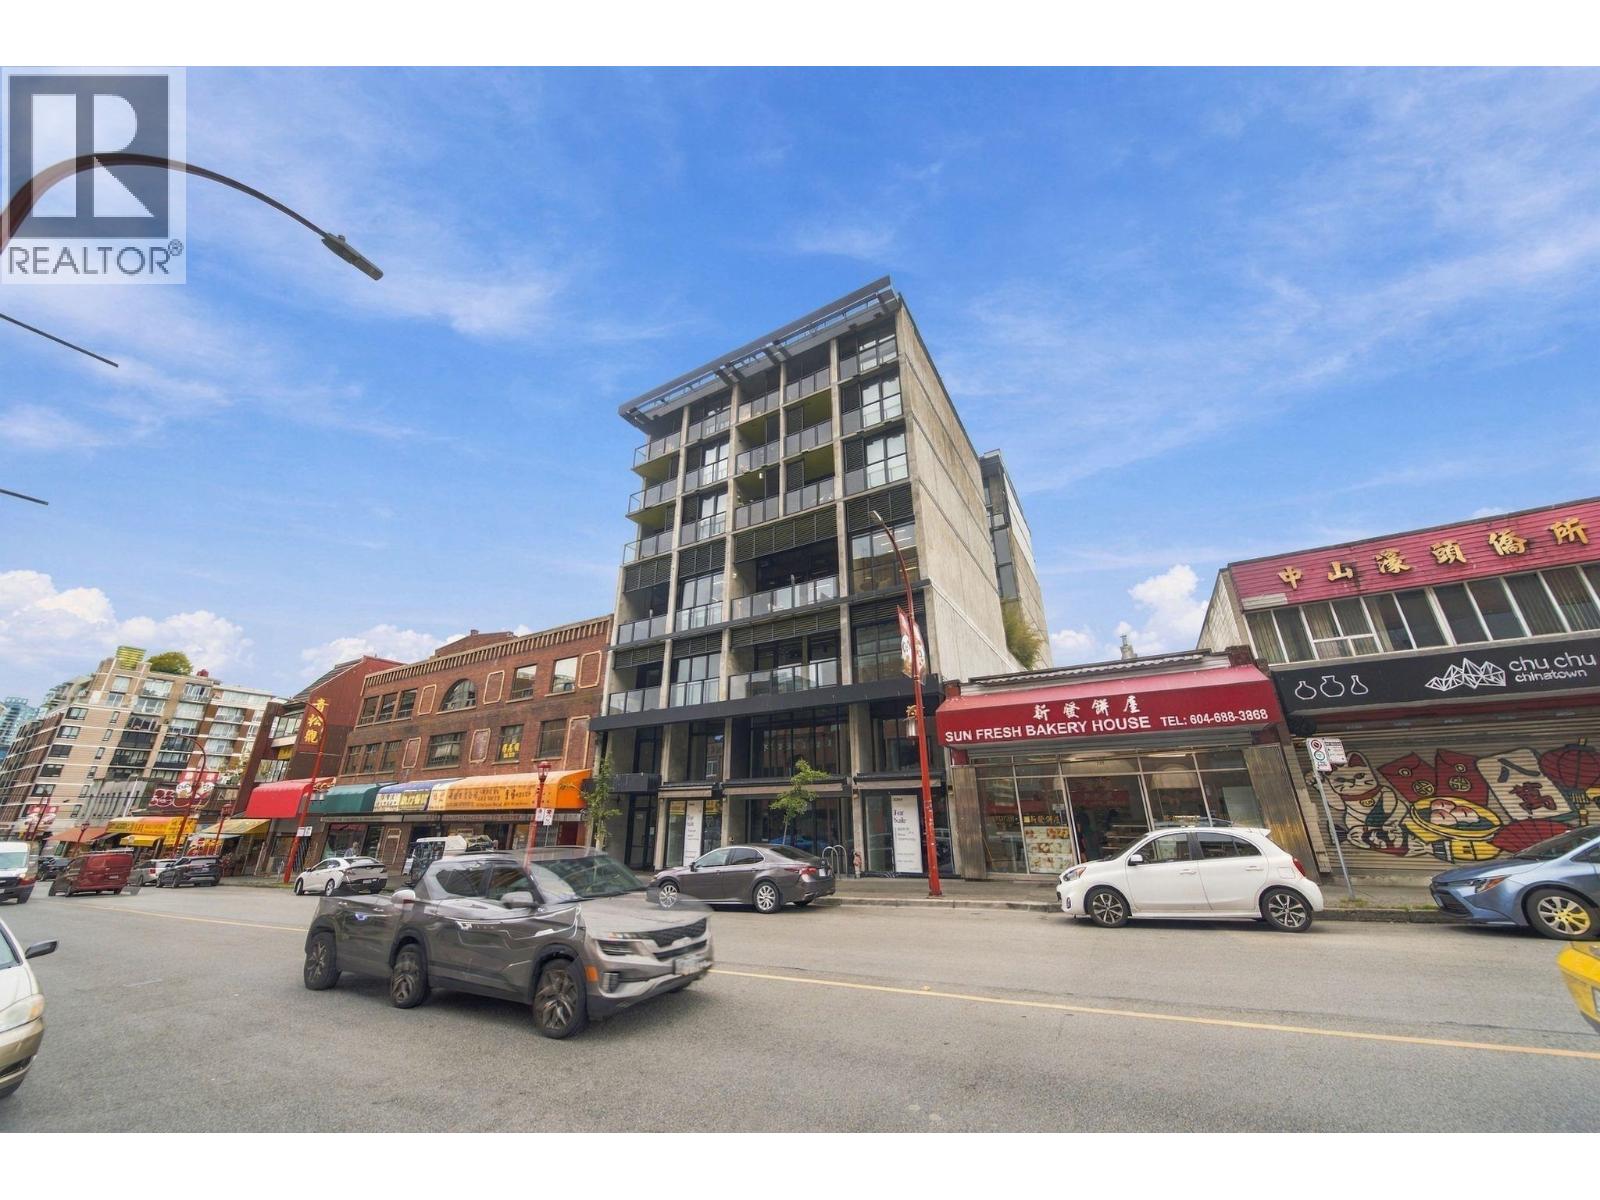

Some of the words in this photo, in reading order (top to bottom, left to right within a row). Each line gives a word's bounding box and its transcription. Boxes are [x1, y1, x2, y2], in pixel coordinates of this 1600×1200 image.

[1508, 656, 1550, 672] chu
[1553, 652, 1597, 668] chu
[1515, 669, 1588, 683] chinatown
[945, 729, 973, 742] SUN
[976, 725, 1022, 740] FRESH
[1025, 720, 1087, 737] BAKERY
[1092, 716, 1152, 732] HOUSE
[1160, 715, 1187, 727] TEL:
[1190, 708, 1268, 725] 604-688-3868
